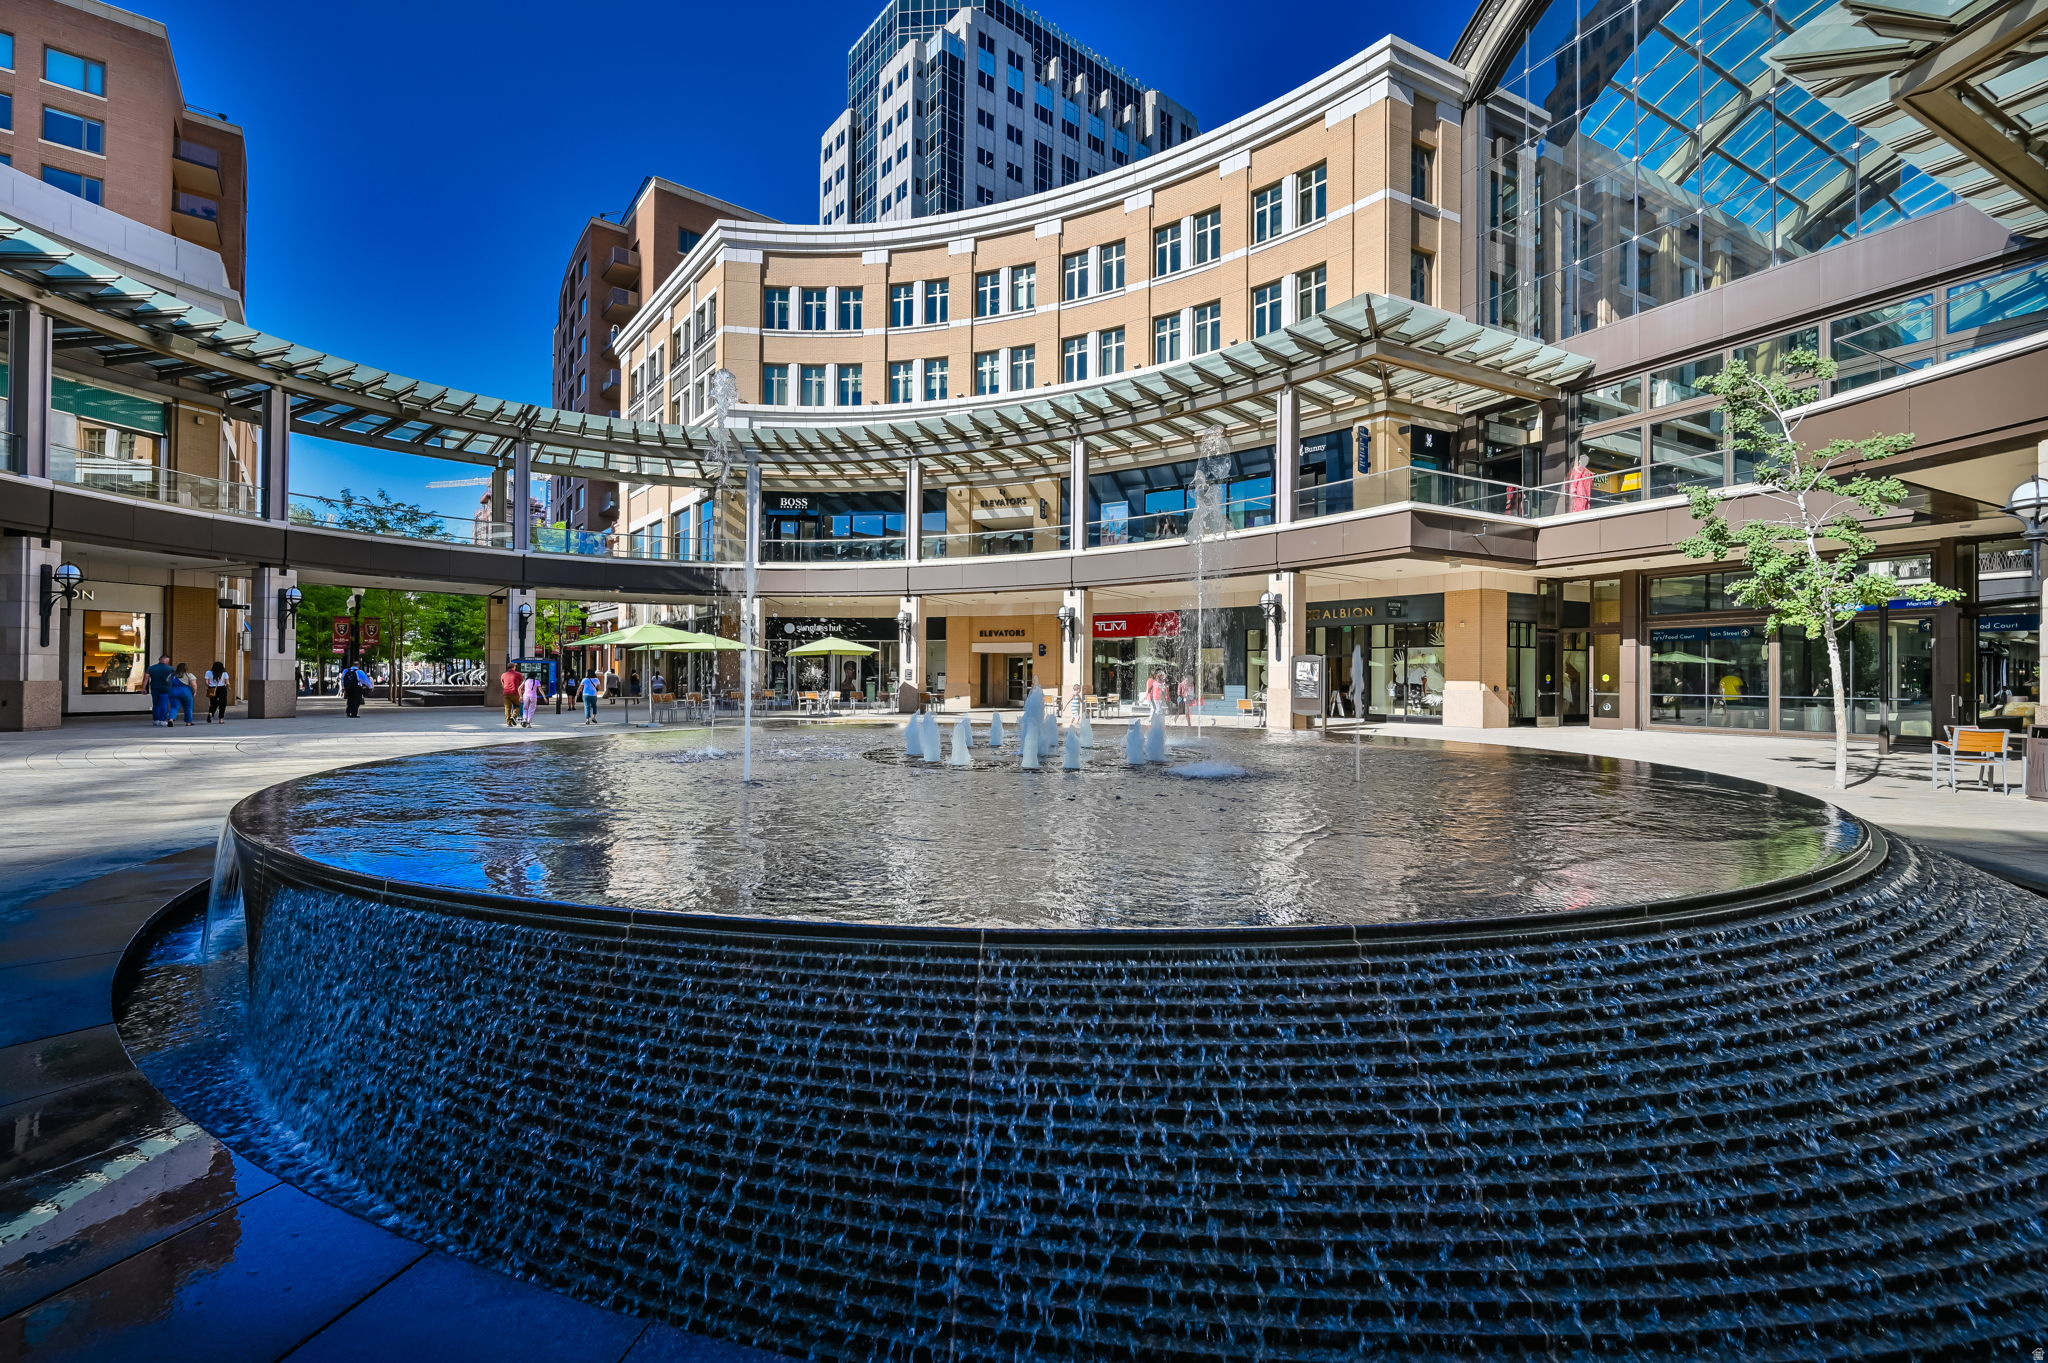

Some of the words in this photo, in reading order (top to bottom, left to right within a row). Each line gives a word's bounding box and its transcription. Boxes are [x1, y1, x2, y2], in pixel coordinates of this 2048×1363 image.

[1304, 444, 1327, 454] Bunny
[780, 497, 808, 506] BOSS
[980, 497, 1027, 507] ELEVATORS
[1322, 606, 1374, 620] ALBION
[796, 623, 828, 635] sunglass
[829, 623, 842, 632] hut
[1095, 620, 1127, 631] TUMI
[979, 629, 1026, 637] ELEVATORS
